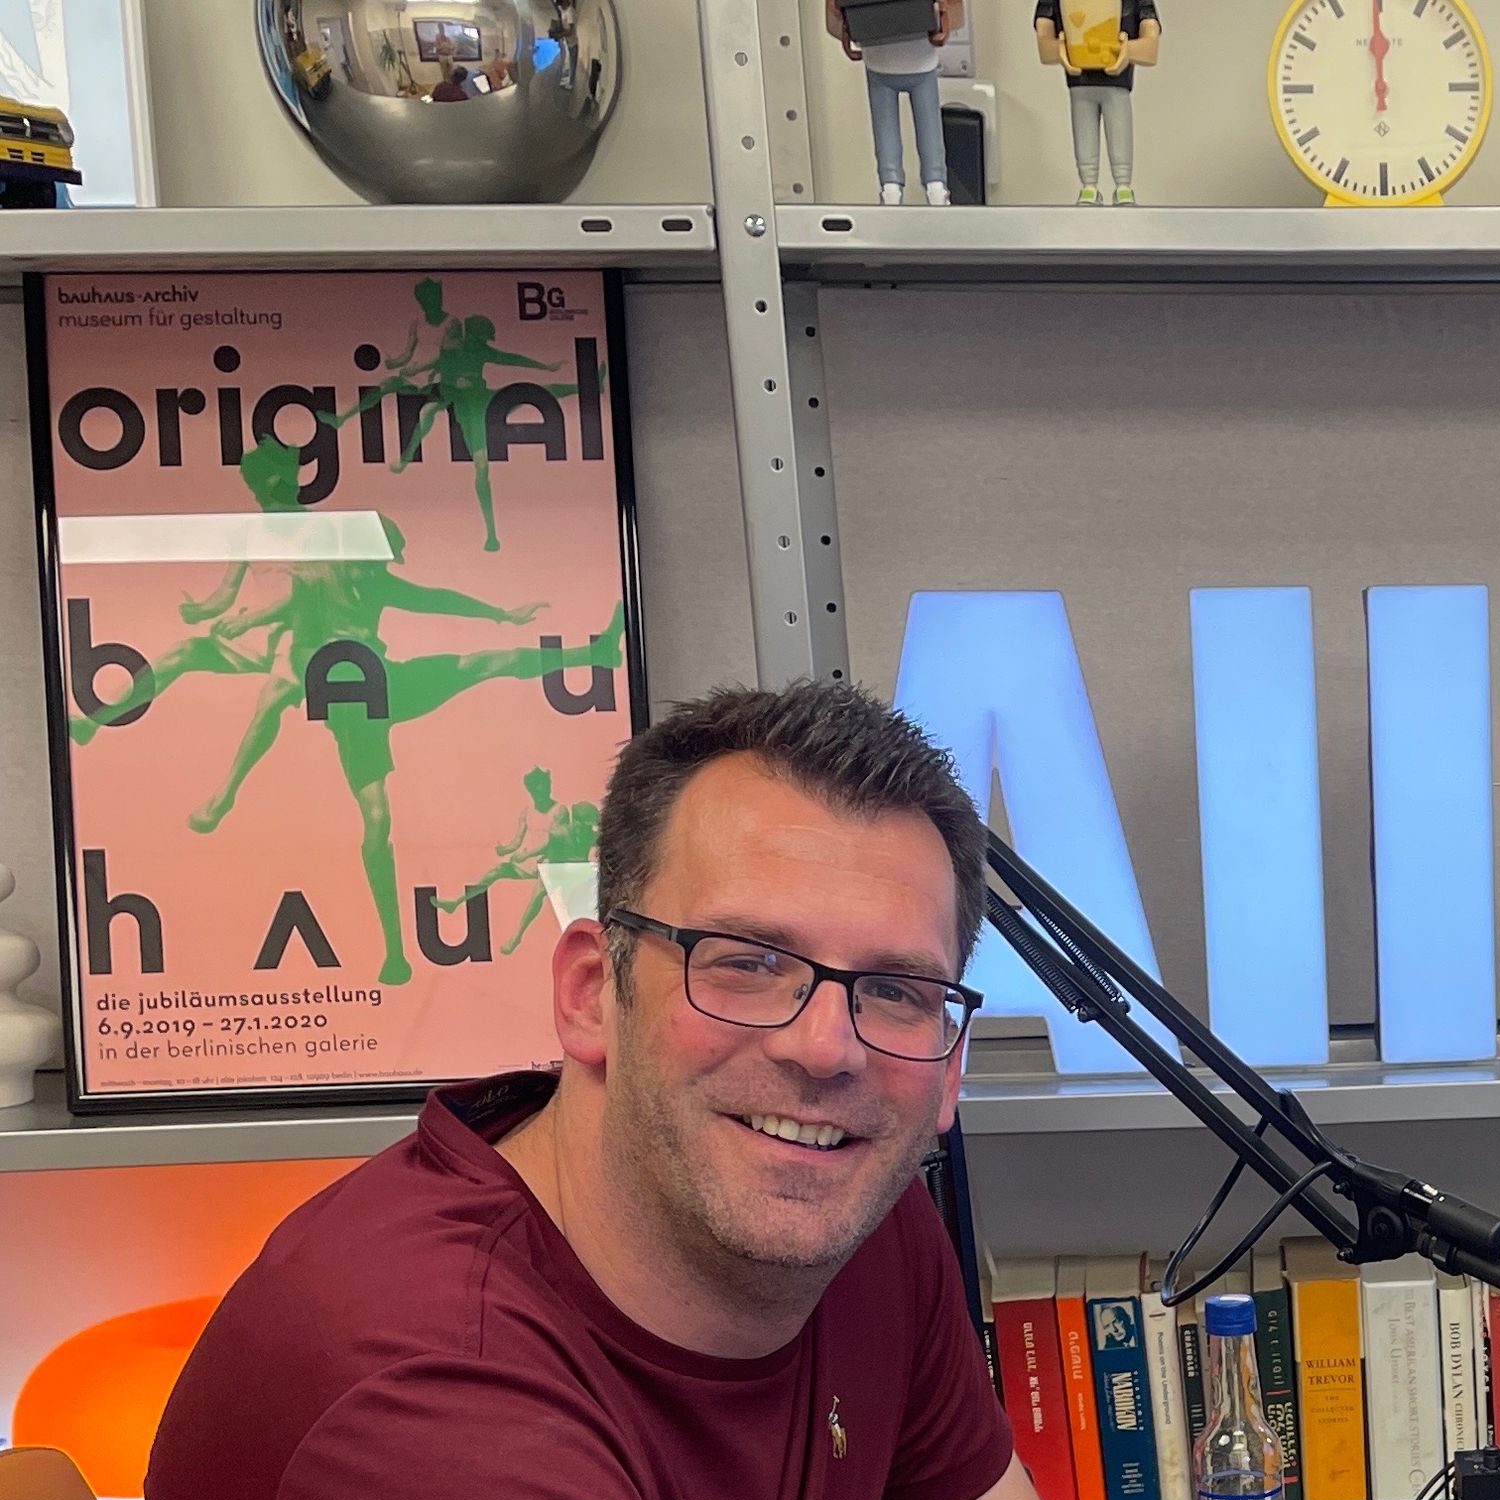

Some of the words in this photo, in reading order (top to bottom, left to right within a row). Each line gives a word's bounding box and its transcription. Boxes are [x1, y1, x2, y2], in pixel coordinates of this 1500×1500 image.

[1356, 37, 1403, 46] NETE
[57, 312, 143, 328] museum
[149, 306, 174, 327] für
[180, 307, 283, 332] gestaltung
[57, 336, 605, 506] original
[96, 993, 131, 1011] die
[137, 985, 382, 1014] jubiläumsausstellung
[97, 1017, 196, 1039] 6.9.2019
[220, 1014, 328, 1032] 27.1.2020
[98, 1042, 117, 1061] in
[125, 1038, 159, 1059] der
[167, 1034, 297, 1059] berlinischen
[305, 1033, 379, 1058] galerie
[1156, 1331, 1166, 1355] Poems
[1449, 1321, 1463, 1349] BOB
[1068, 1330, 1084, 1380] טיפשות
[1158, 1356, 1166, 1366] on
[1183, 1329, 1195, 1378] CHANDLER
[1305, 1358, 1356, 1369] WILLIAM
[1405, 1329, 1418, 1385] AMERICAN
[1159, 1366, 1168, 1379] the
[1308, 1374, 1354, 1386] TREVOR
[1450, 1354, 1465, 1399] DYLAN
[1111, 1371, 1137, 1431] NABOKOV
[1159, 1380, 1172, 1425] Underground
